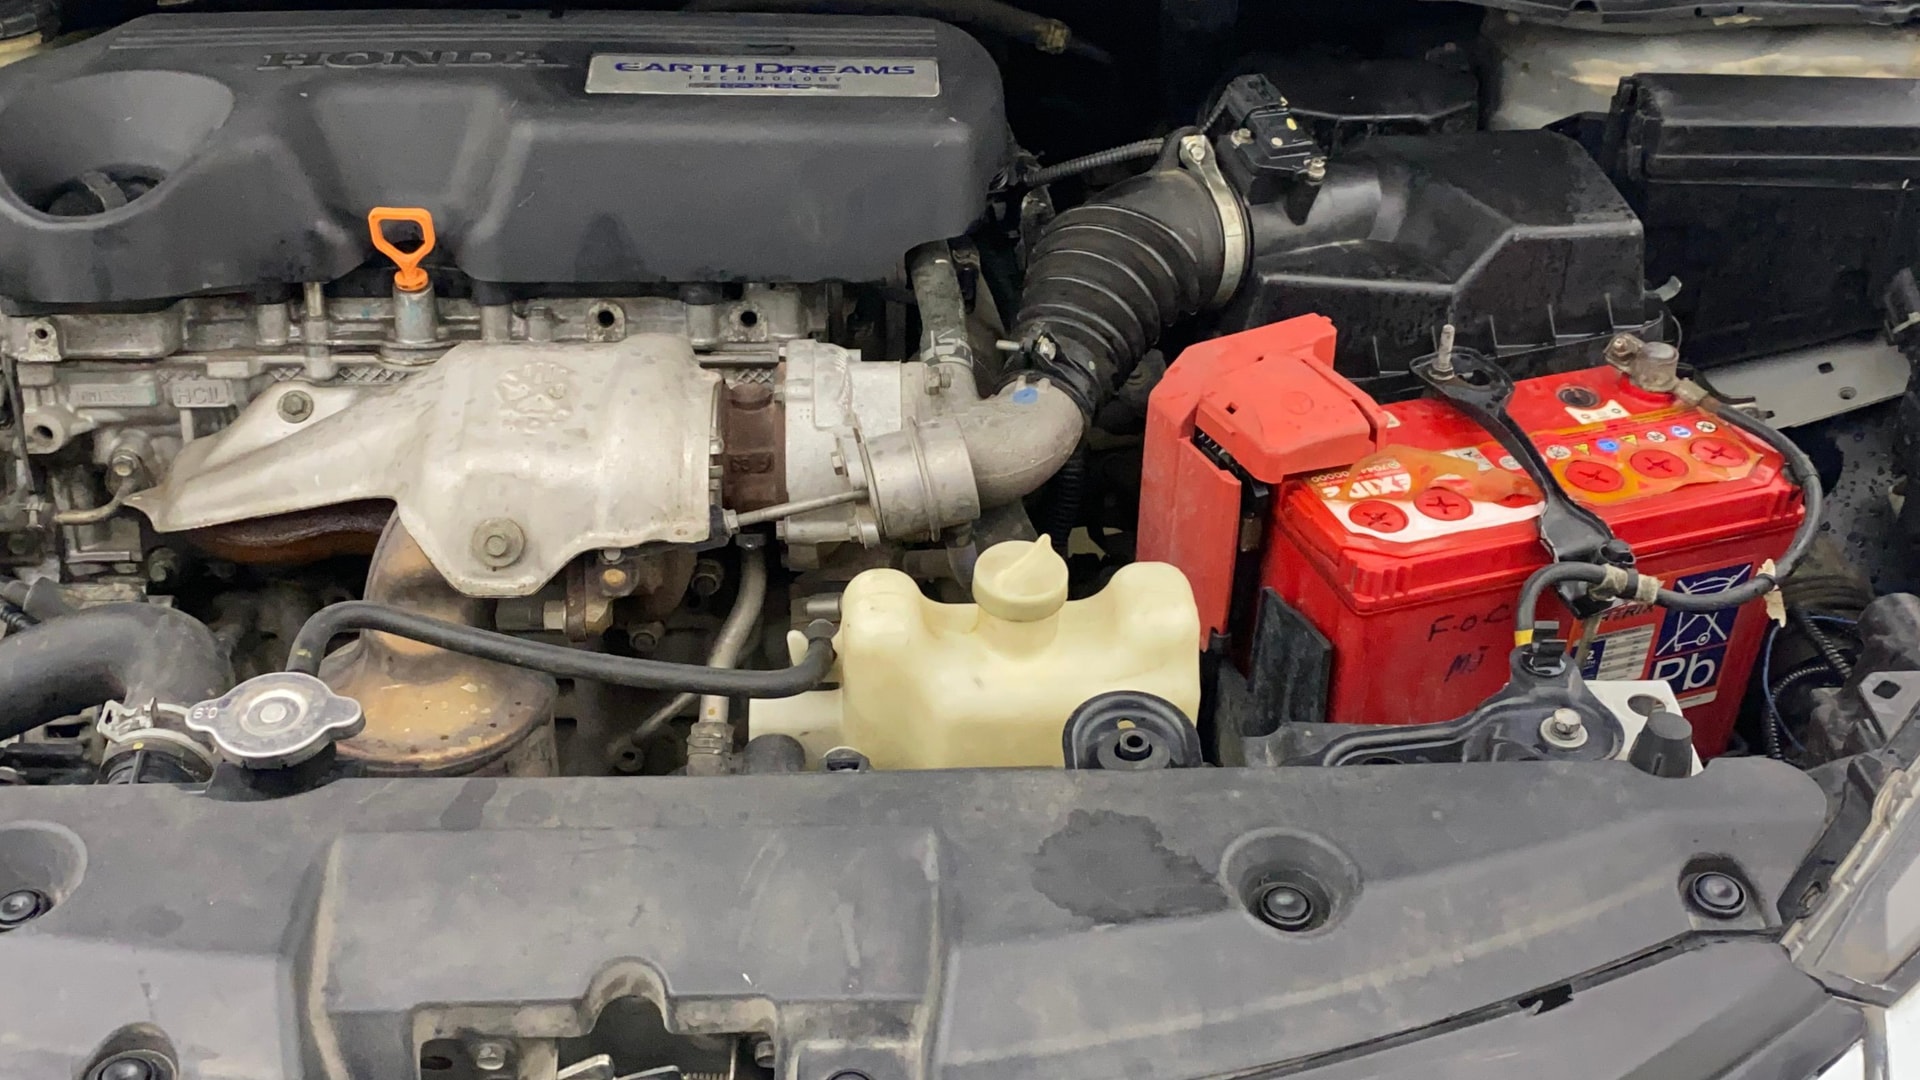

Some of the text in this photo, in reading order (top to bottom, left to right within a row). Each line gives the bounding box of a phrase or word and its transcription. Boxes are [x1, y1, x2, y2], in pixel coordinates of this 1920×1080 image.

[256, 50, 569, 70] HONDA
[614, 62, 915, 75] EARTH DREAMS
[1653, 652, 1716, 690] Pb
